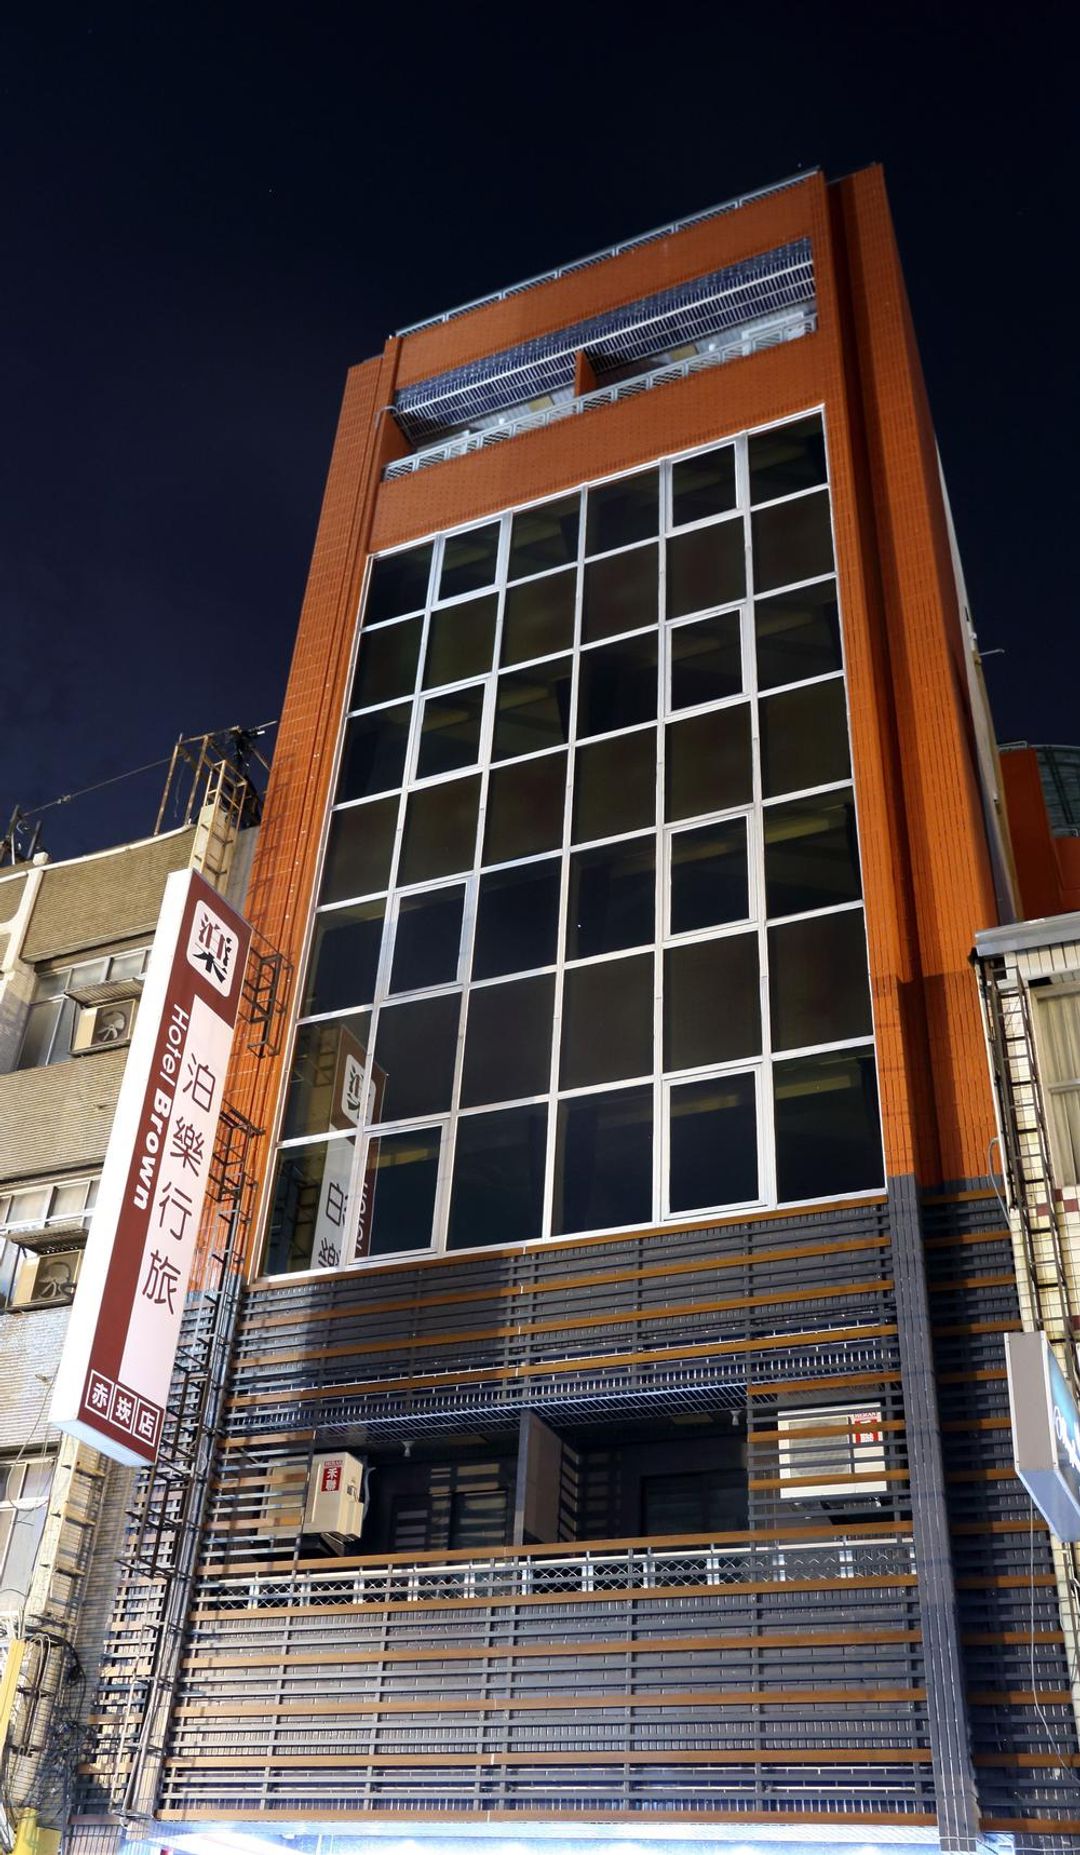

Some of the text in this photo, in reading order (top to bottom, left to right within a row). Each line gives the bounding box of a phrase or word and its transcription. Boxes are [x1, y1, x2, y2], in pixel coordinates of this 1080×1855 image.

[133, 1003, 190, 1210] Hotel Brown
[142, 1053, 216, 1315] 泊樂行旅
[92, 1382, 156, 1439] 赤崁店
